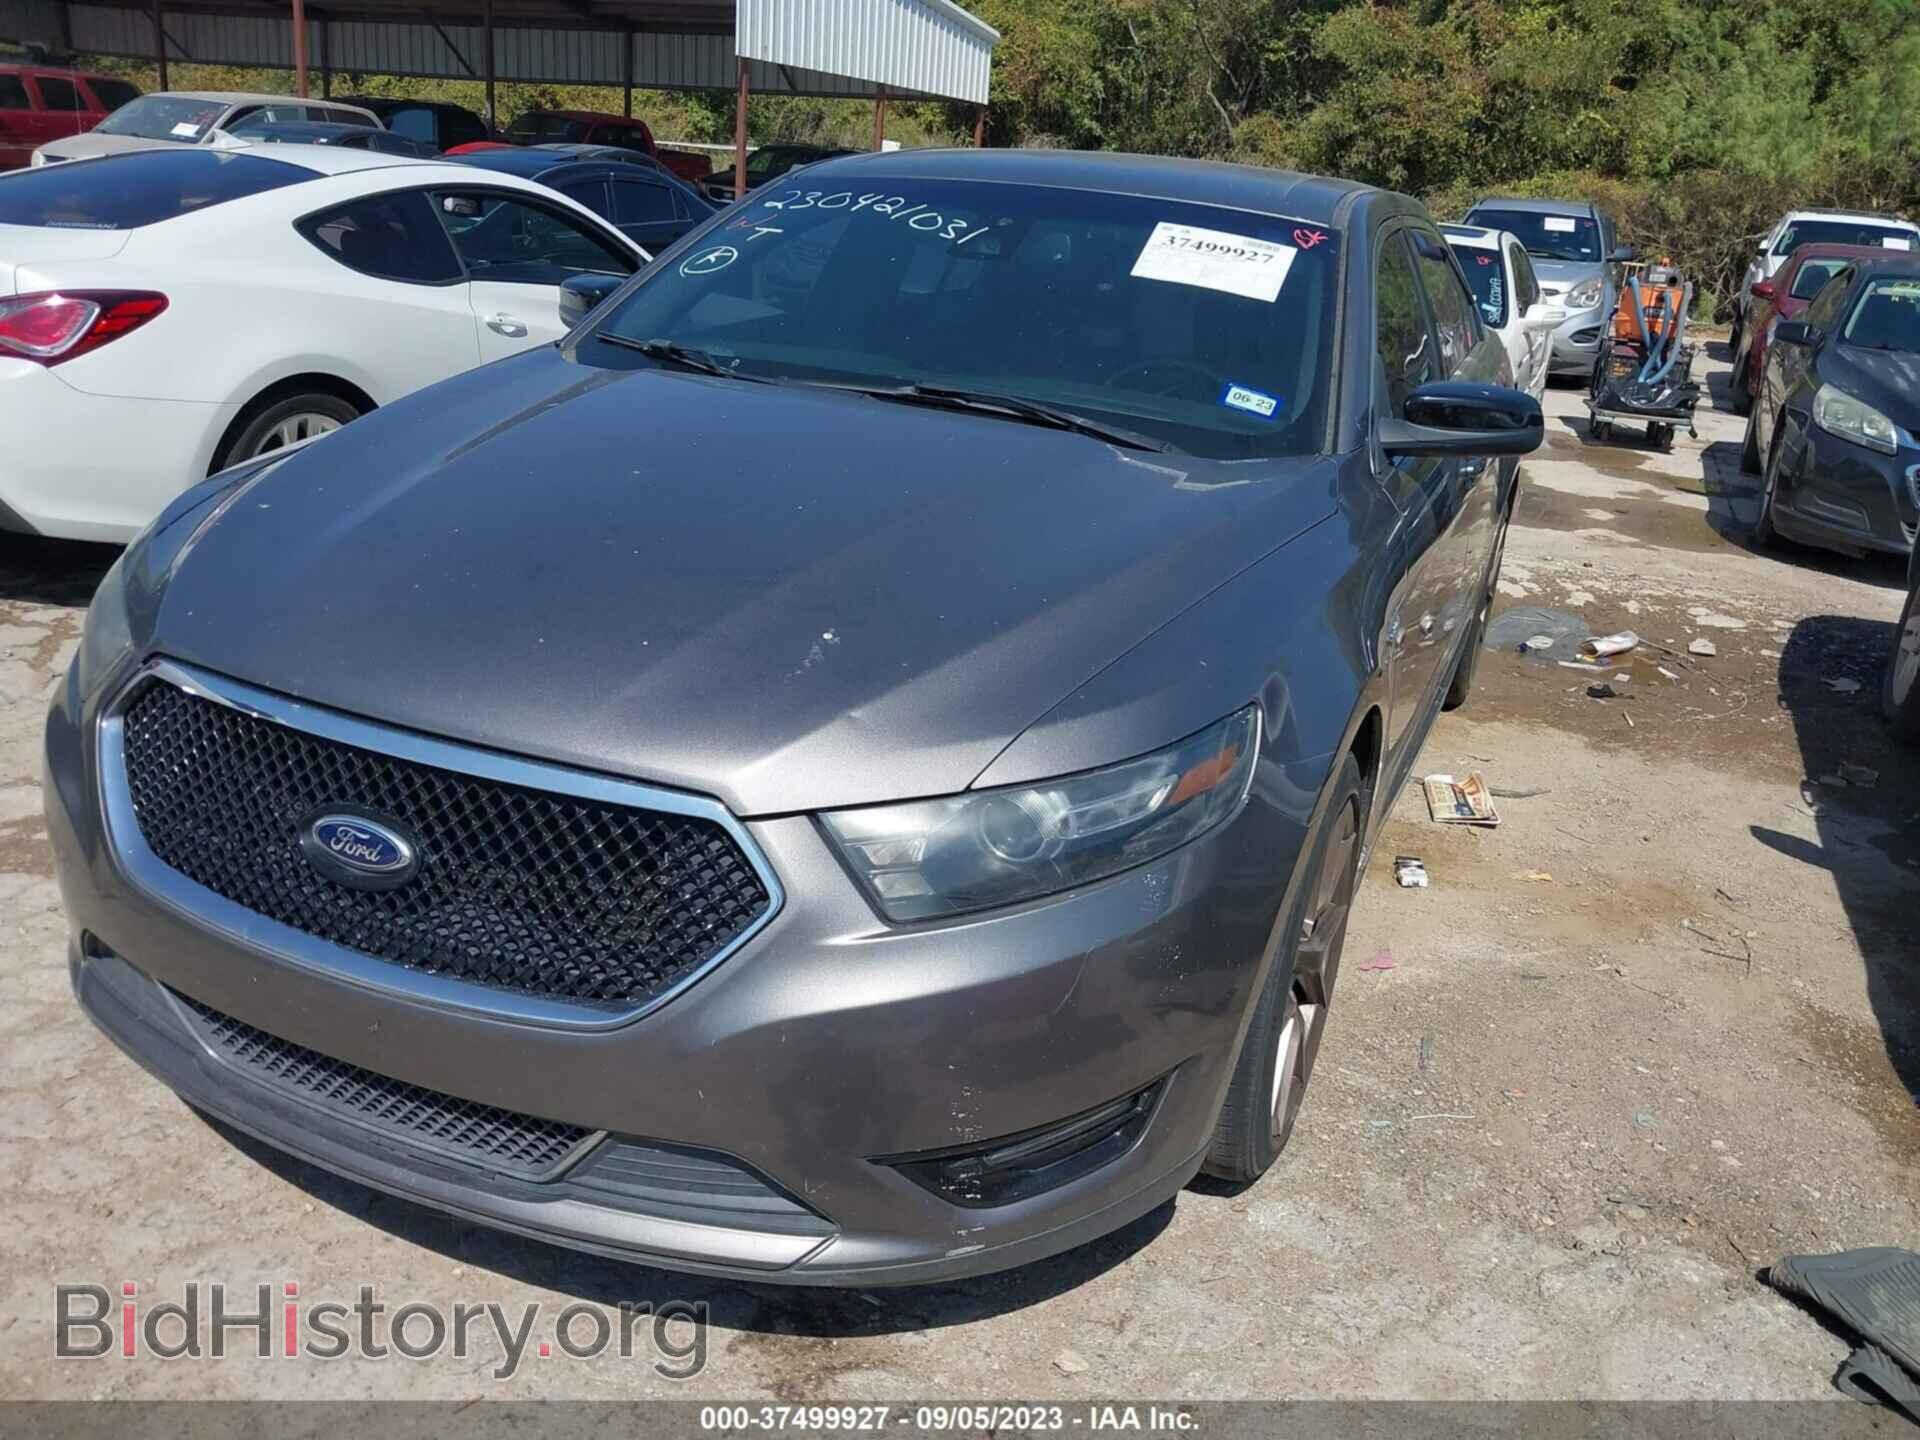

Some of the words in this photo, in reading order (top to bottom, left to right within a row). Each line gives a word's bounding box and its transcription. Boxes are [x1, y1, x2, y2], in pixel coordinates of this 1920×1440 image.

[764, 190, 989, 244] 230421031
[1161, 235, 1275, 264] 37499927
[330, 826, 381, 862] Ford
